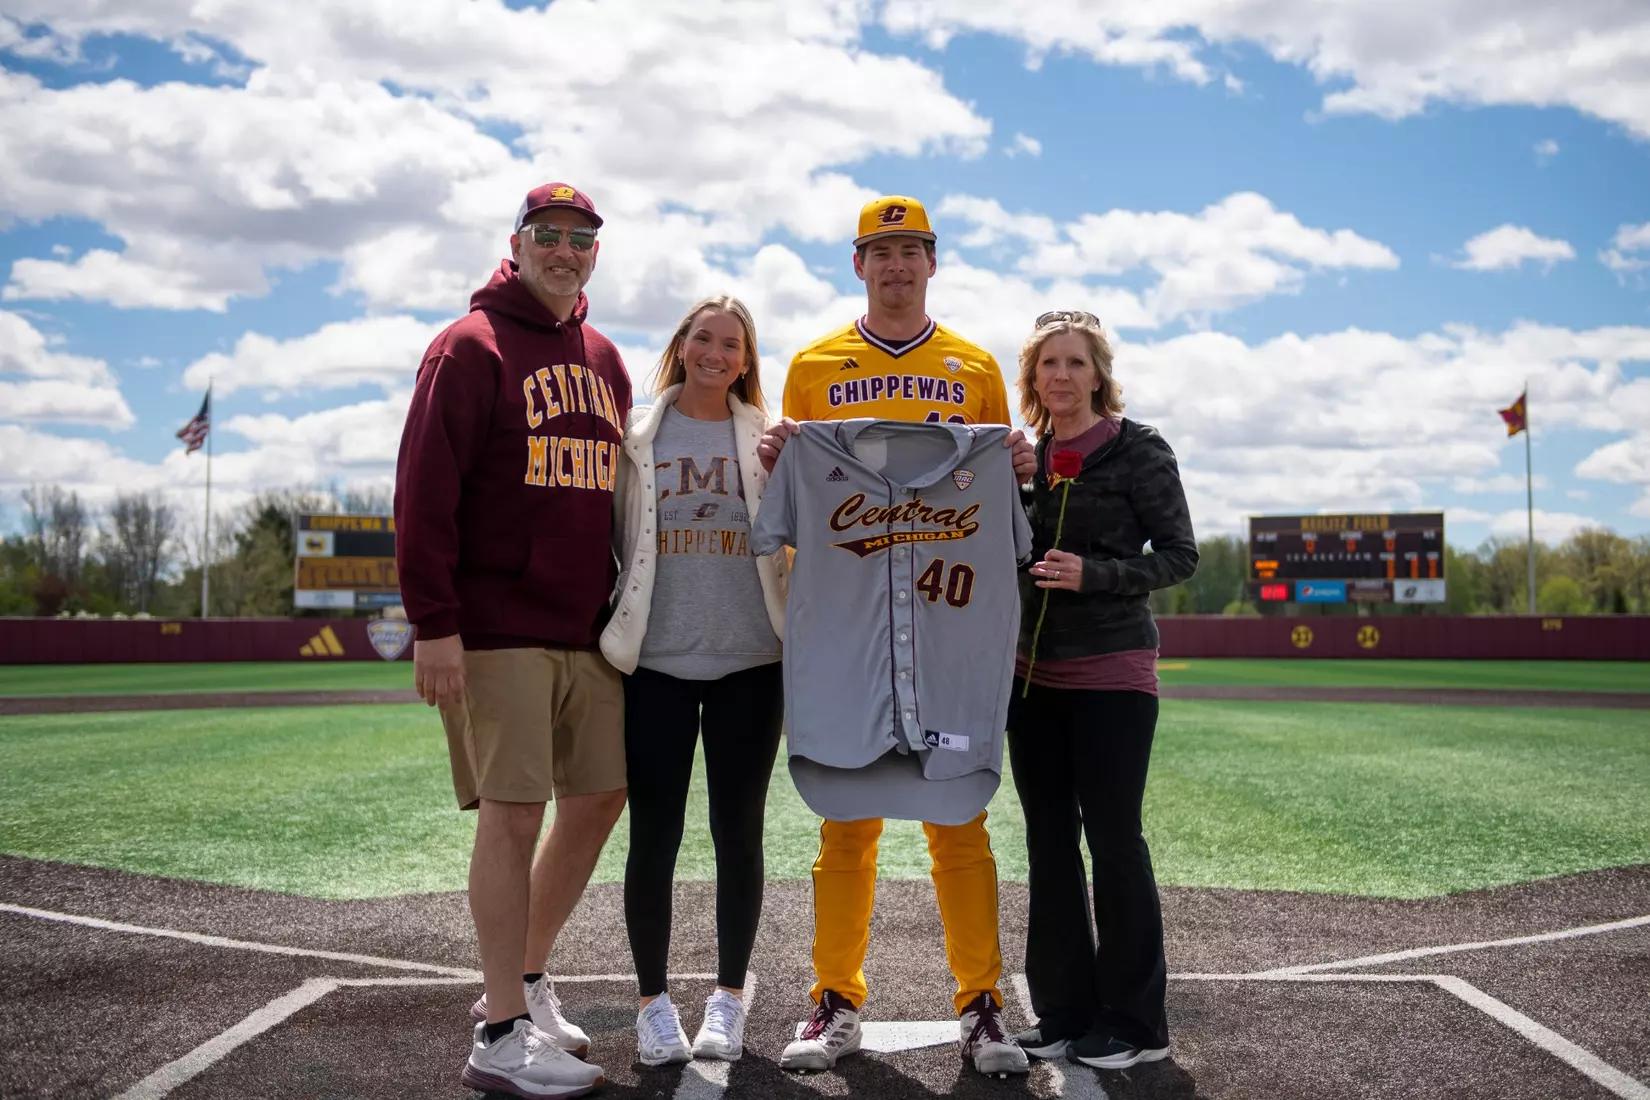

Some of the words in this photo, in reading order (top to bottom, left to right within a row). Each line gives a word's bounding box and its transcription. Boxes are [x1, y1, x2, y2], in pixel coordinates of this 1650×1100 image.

[828, 374, 966, 408] CHIPPEWAS
[525, 436, 621, 492] MICHIGA
[663, 511, 678, 521] EST
[829, 492, 982, 532] Central
[656, 530, 749, 556] HIPPEWA
[864, 529, 965, 550] MICHIGAN
[916, 558, 976, 608] 40
[941, 737, 950, 745] 48
